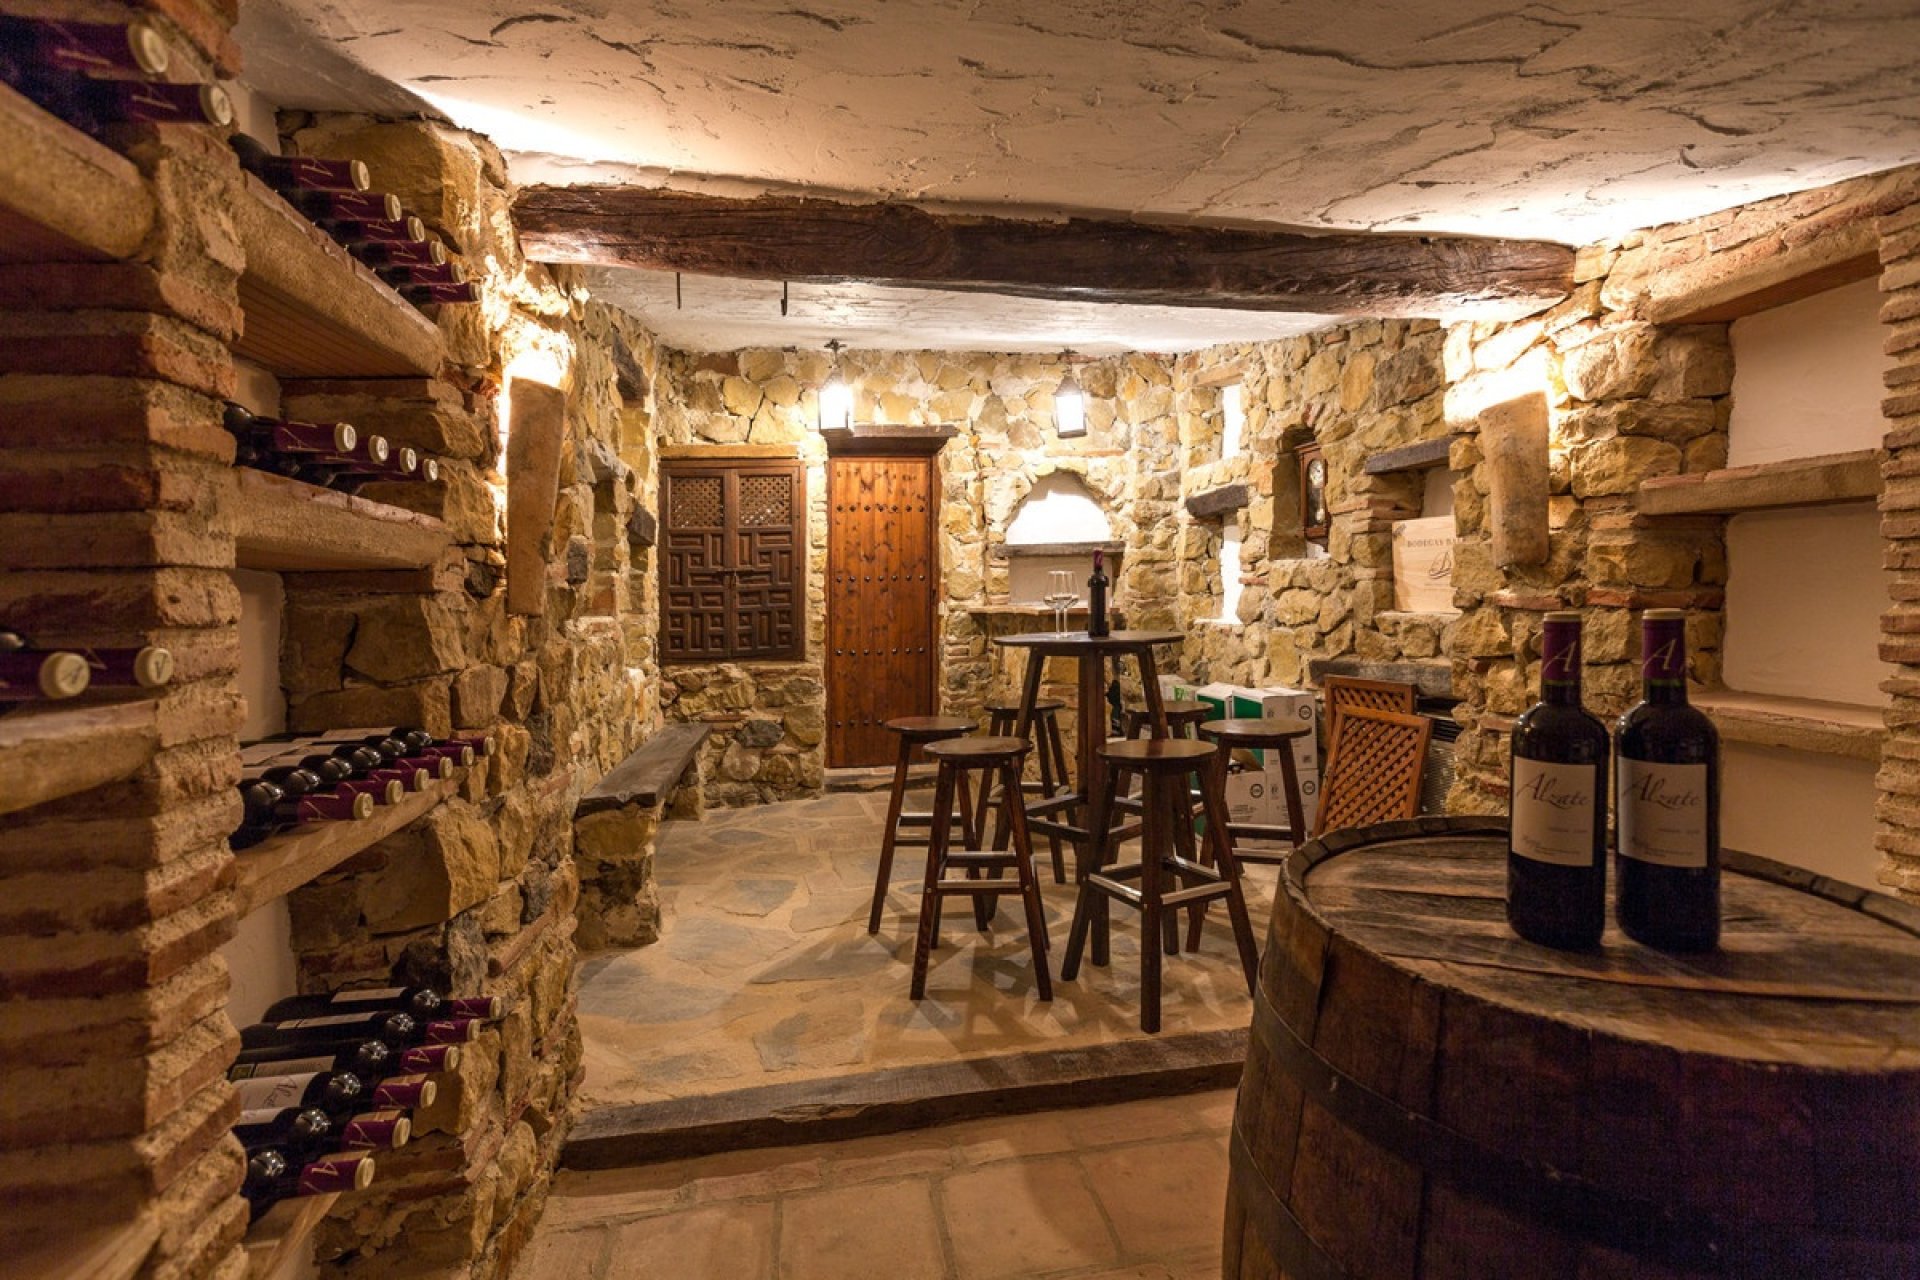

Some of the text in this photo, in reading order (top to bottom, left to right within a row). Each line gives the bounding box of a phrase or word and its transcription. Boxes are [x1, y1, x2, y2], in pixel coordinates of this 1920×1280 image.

[1544, 640, 1577, 672] A
[1642, 639, 1676, 670] A
[1516, 772, 1590, 810] Alzate
[1623, 773, 1702, 810] Alzate
